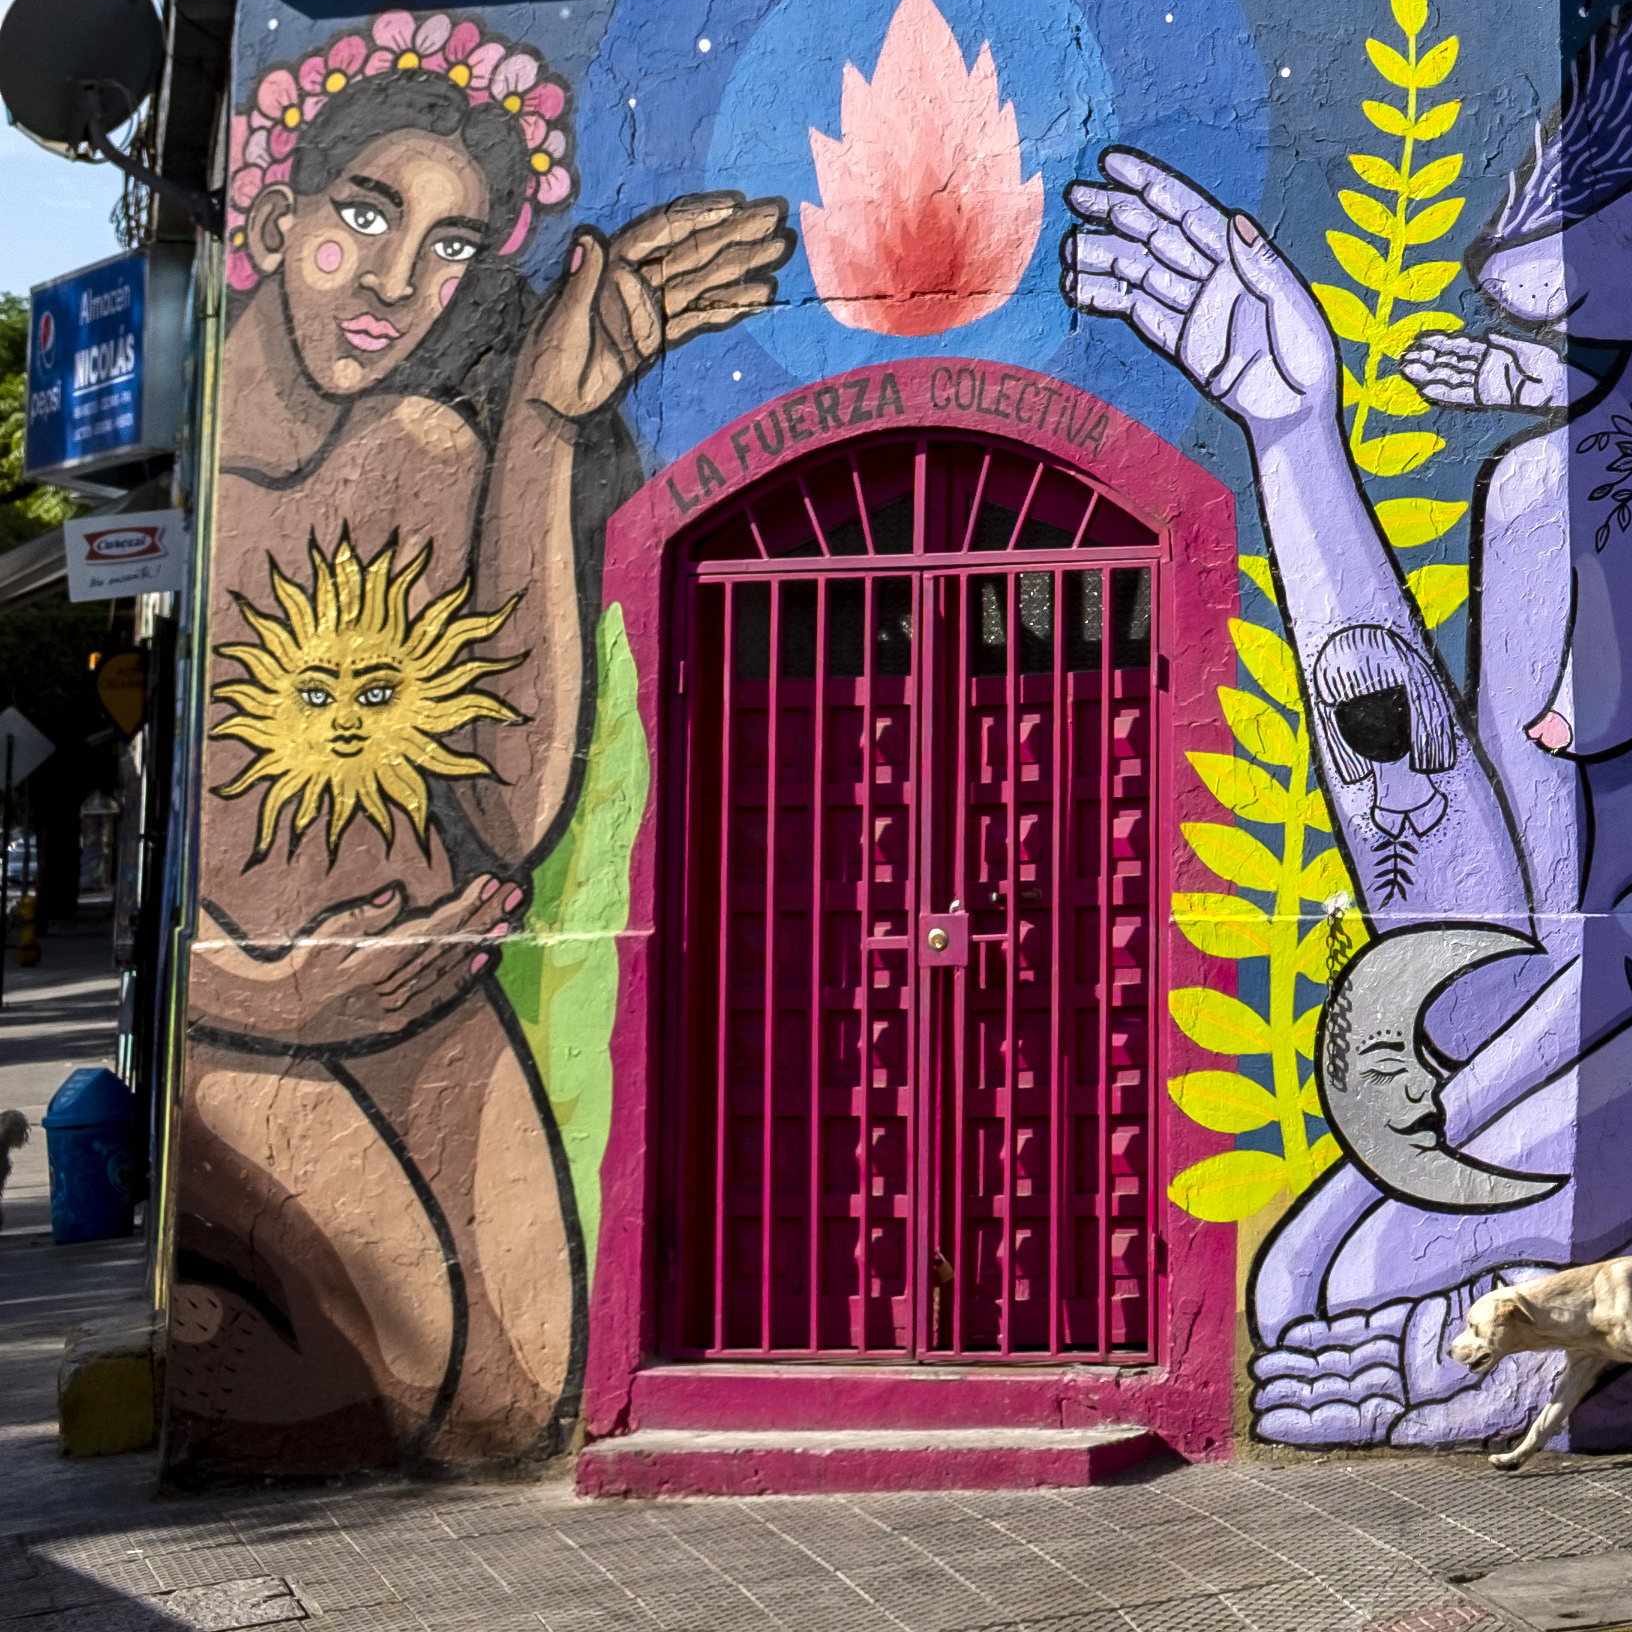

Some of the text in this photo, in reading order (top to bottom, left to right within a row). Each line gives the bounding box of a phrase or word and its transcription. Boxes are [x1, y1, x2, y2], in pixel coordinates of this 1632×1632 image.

[79, 278, 131, 326] Almacén
[74, 324, 136, 387] NICOLÁS
[30, 379, 62, 425] pepsi
[667, 455, 725, 515] LA
[731, 372, 905, 471] FUERZA
